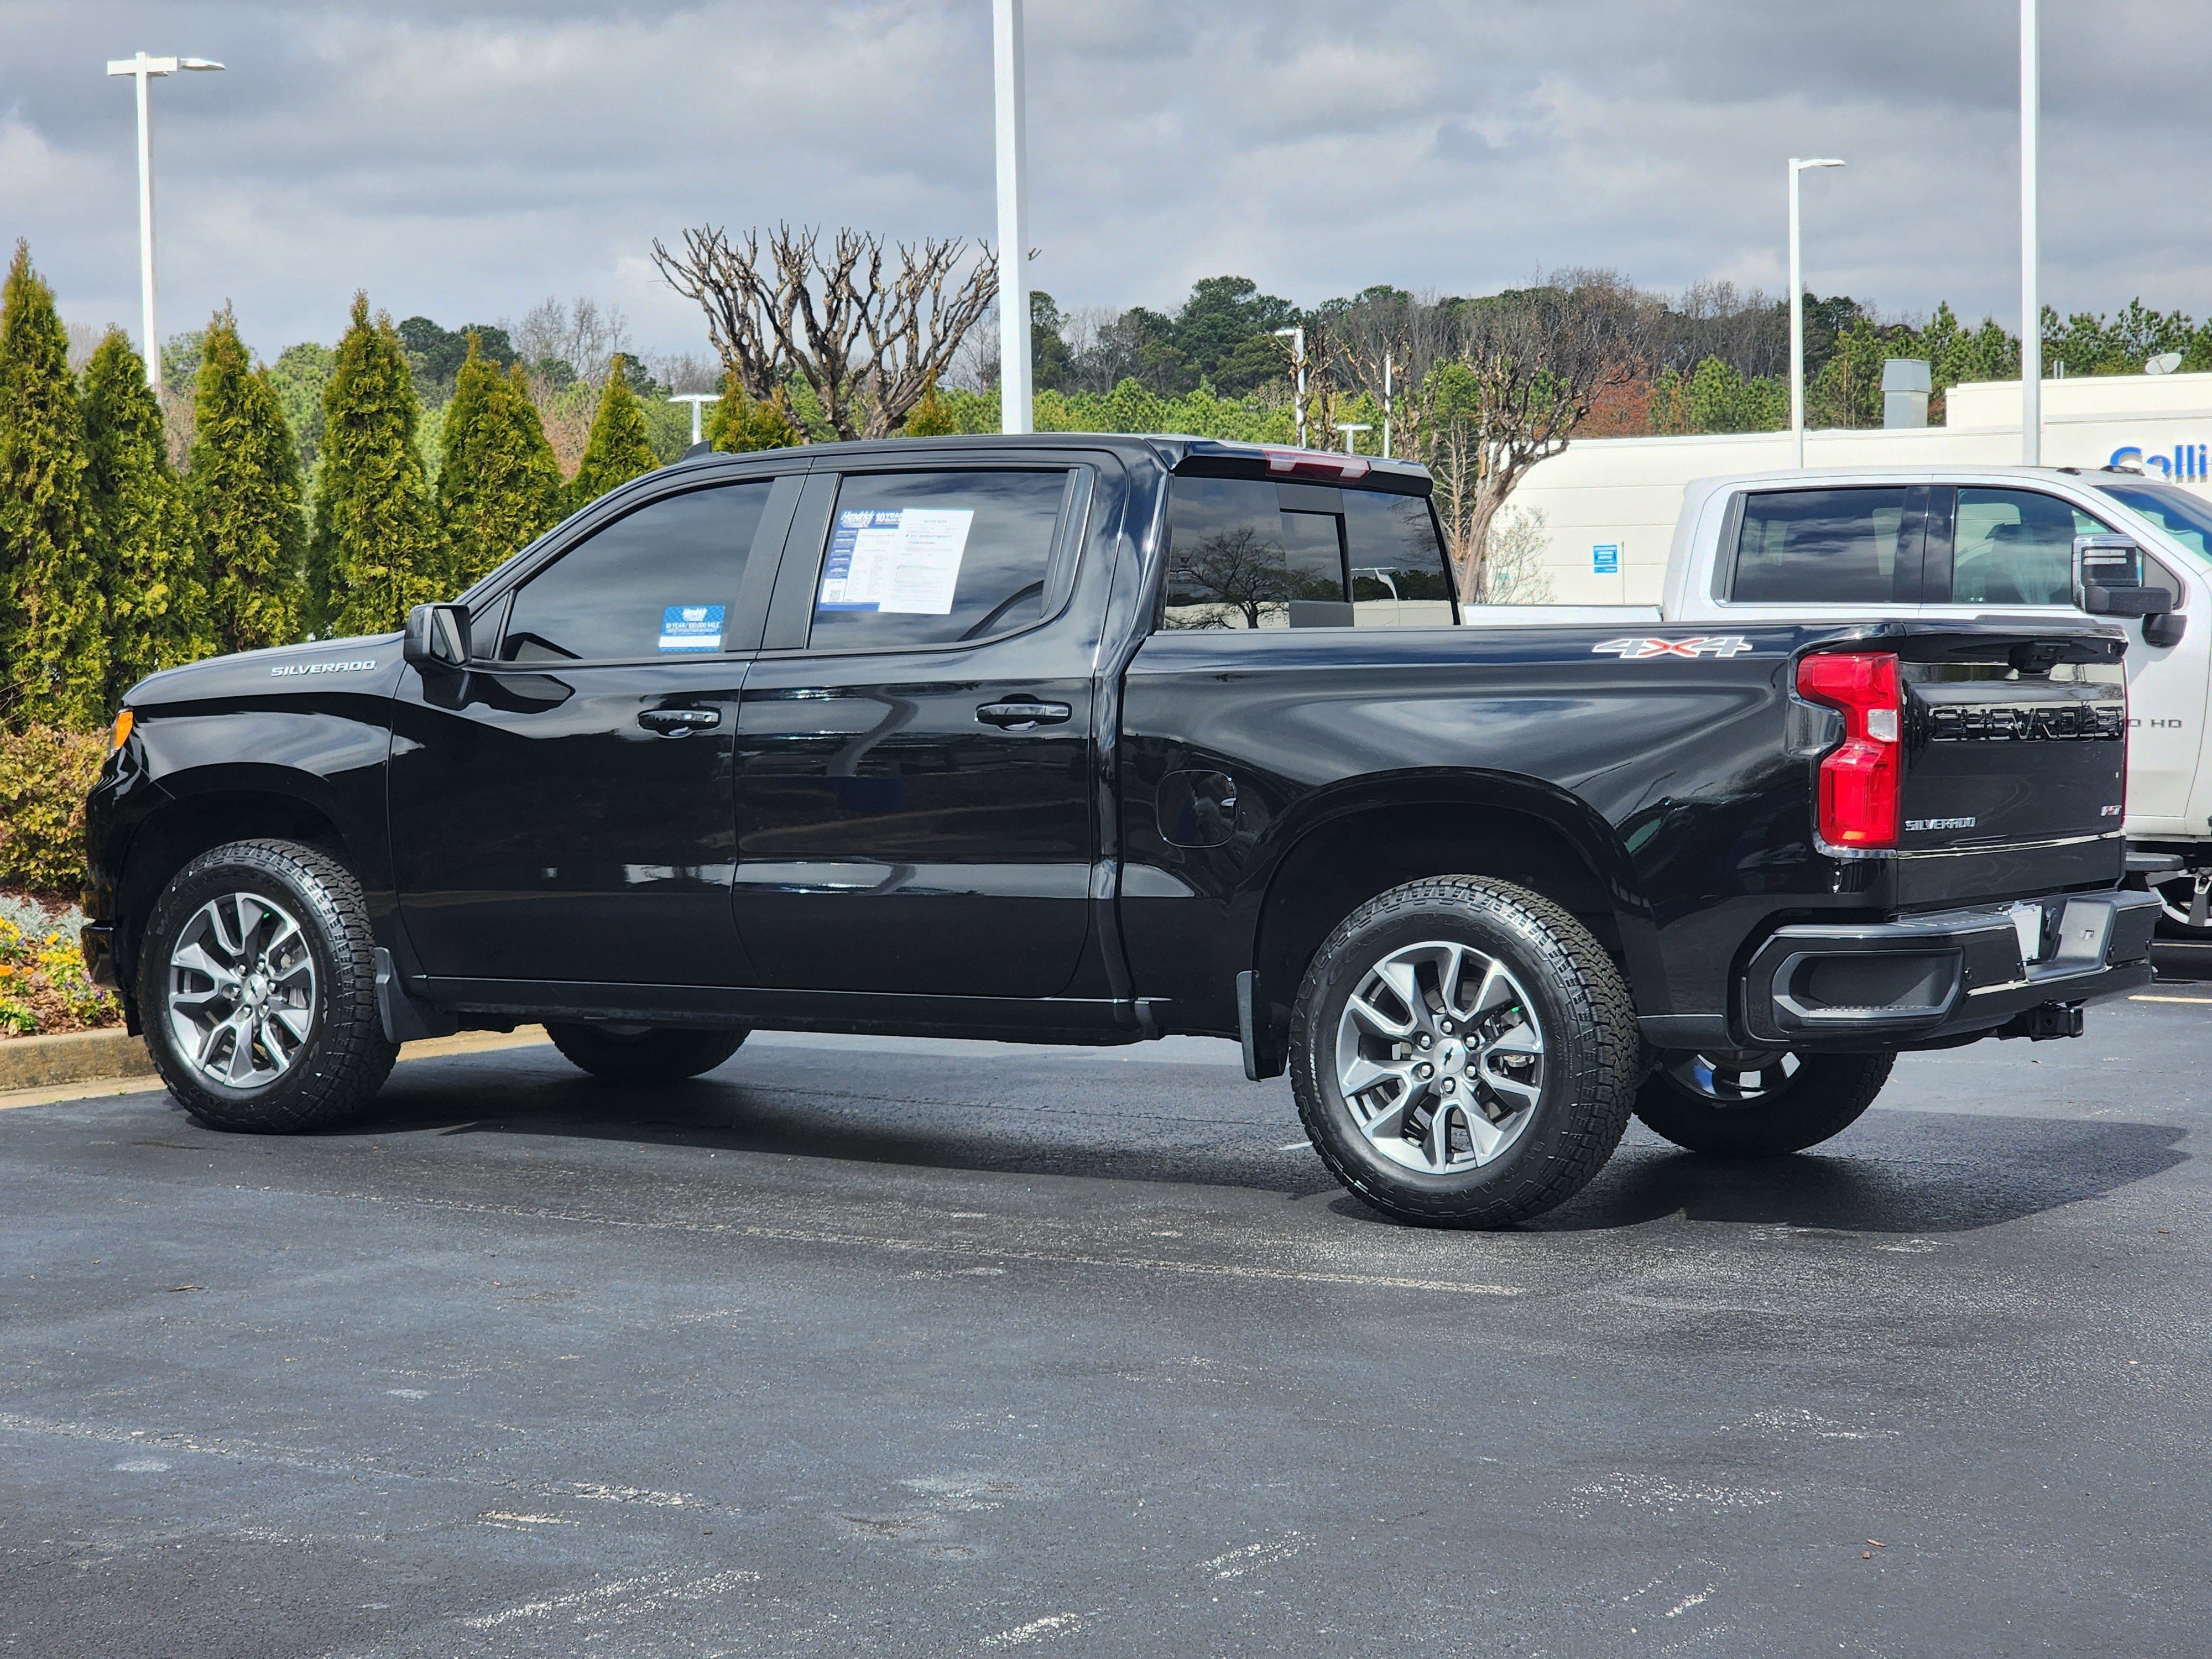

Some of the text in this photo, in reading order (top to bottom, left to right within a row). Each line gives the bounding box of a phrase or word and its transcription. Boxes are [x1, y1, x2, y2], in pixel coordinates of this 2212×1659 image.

[2110, 444, 2212, 476] Colli
[270, 660, 377, 677] SILVERADO
[2151, 719, 2182, 728] HD
[1905, 817, 1976, 831] SILVERADO
